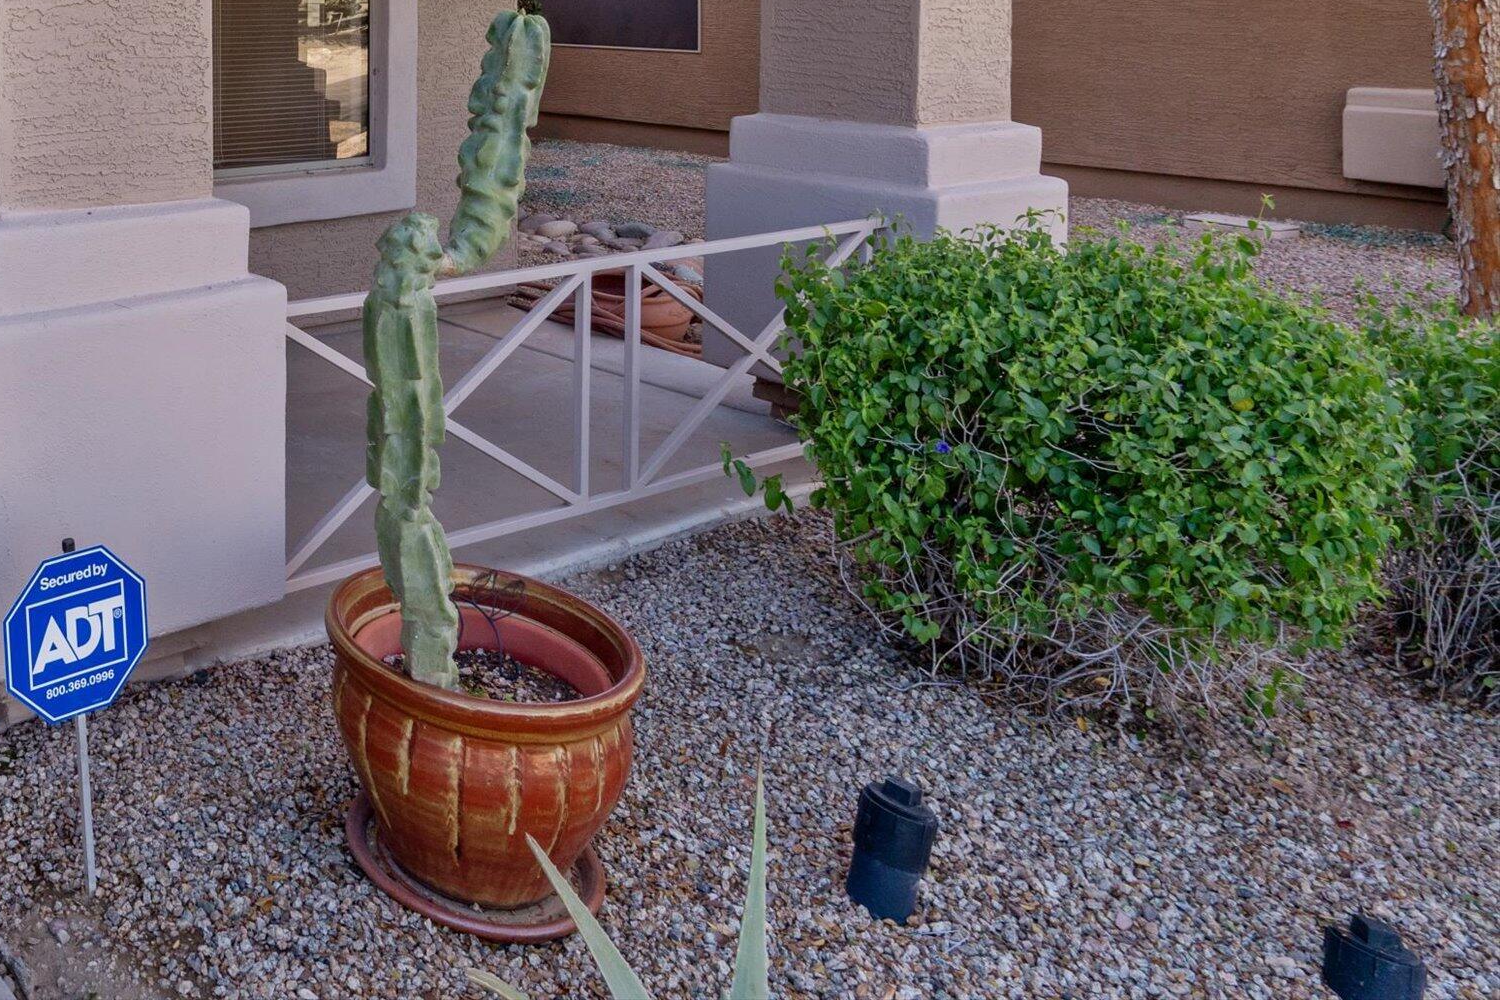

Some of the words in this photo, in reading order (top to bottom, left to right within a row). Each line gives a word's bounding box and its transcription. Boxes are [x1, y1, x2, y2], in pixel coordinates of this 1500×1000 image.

[40, 566, 92, 591] Secured
[92, 563, 108, 577] by
[32, 594, 124, 675] ADT
[46, 669, 115, 700] 800.369.0996
